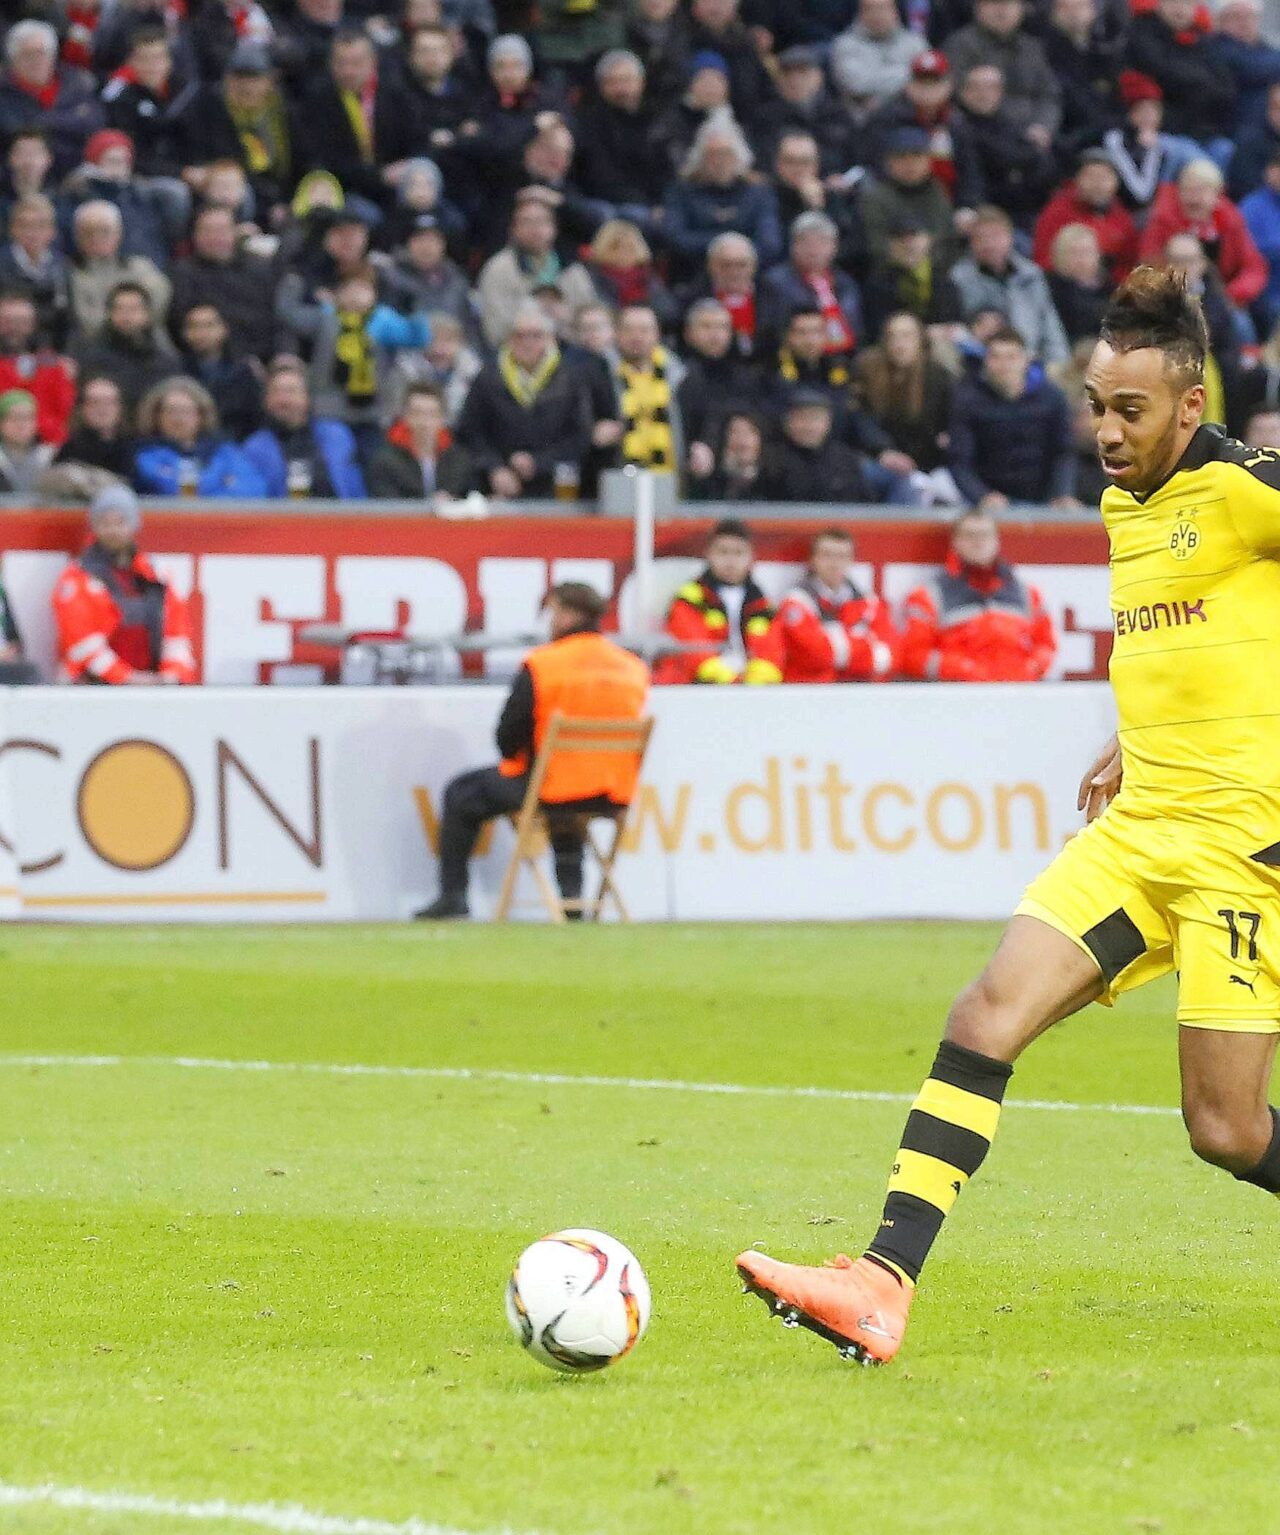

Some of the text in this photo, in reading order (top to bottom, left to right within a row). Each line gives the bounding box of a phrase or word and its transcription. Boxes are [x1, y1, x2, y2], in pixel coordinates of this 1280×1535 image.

[1170, 523, 1198, 549] BVB
[1116, 599, 1207, 636] EVONIK
[1218, 910, 1262, 961] 17
